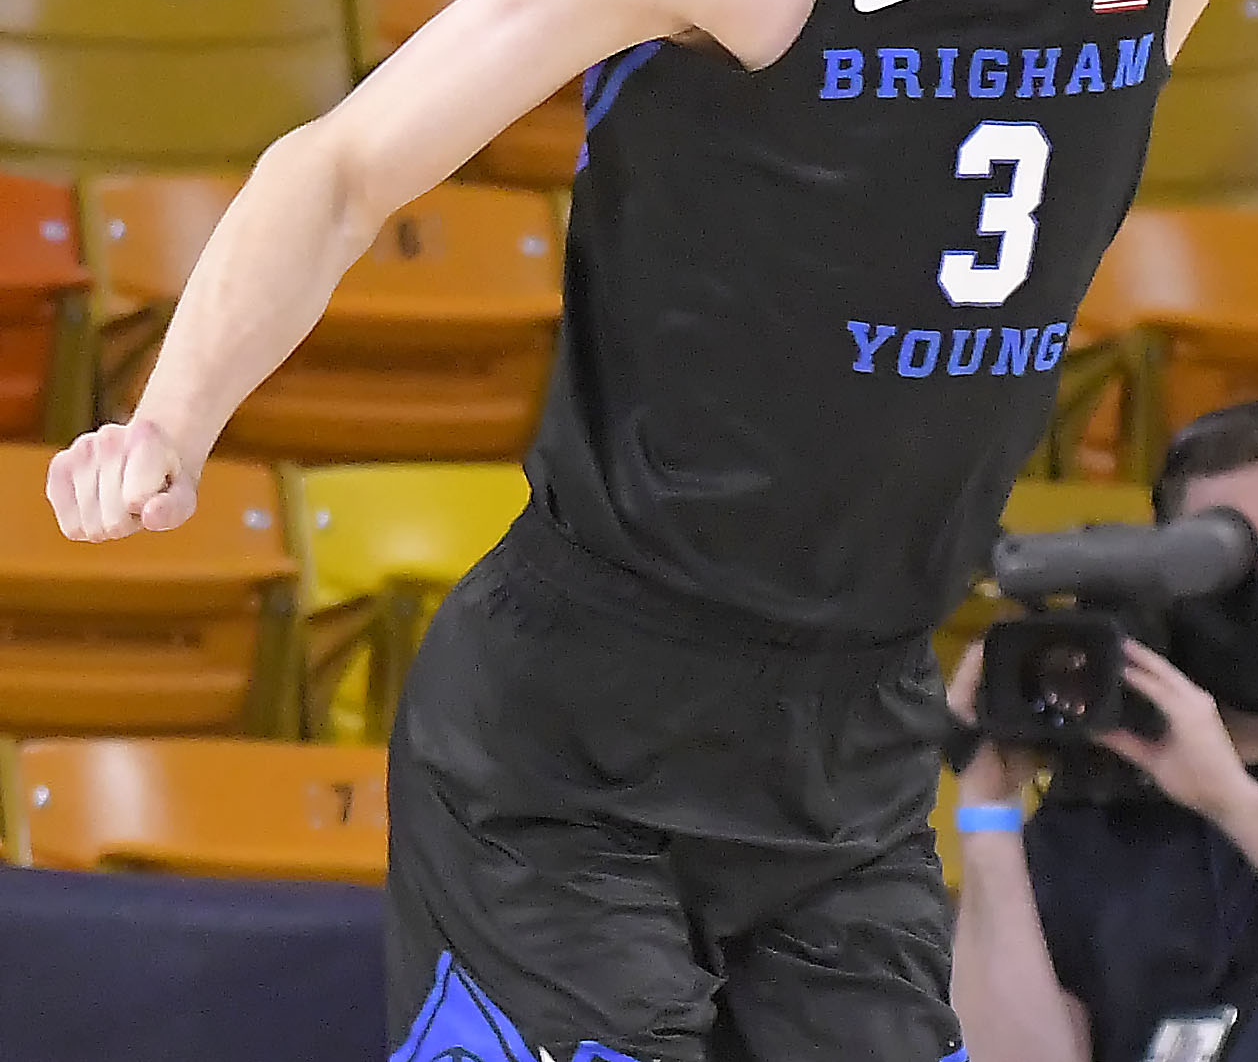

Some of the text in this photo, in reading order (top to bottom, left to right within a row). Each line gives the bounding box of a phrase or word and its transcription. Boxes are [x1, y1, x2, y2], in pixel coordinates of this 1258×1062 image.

[819, 33, 1155, 99] BRIGHAM
[937, 120, 1052, 307] 3
[847, 321, 1069, 378] YOUNG
[331, 783, 355, 824] 7
